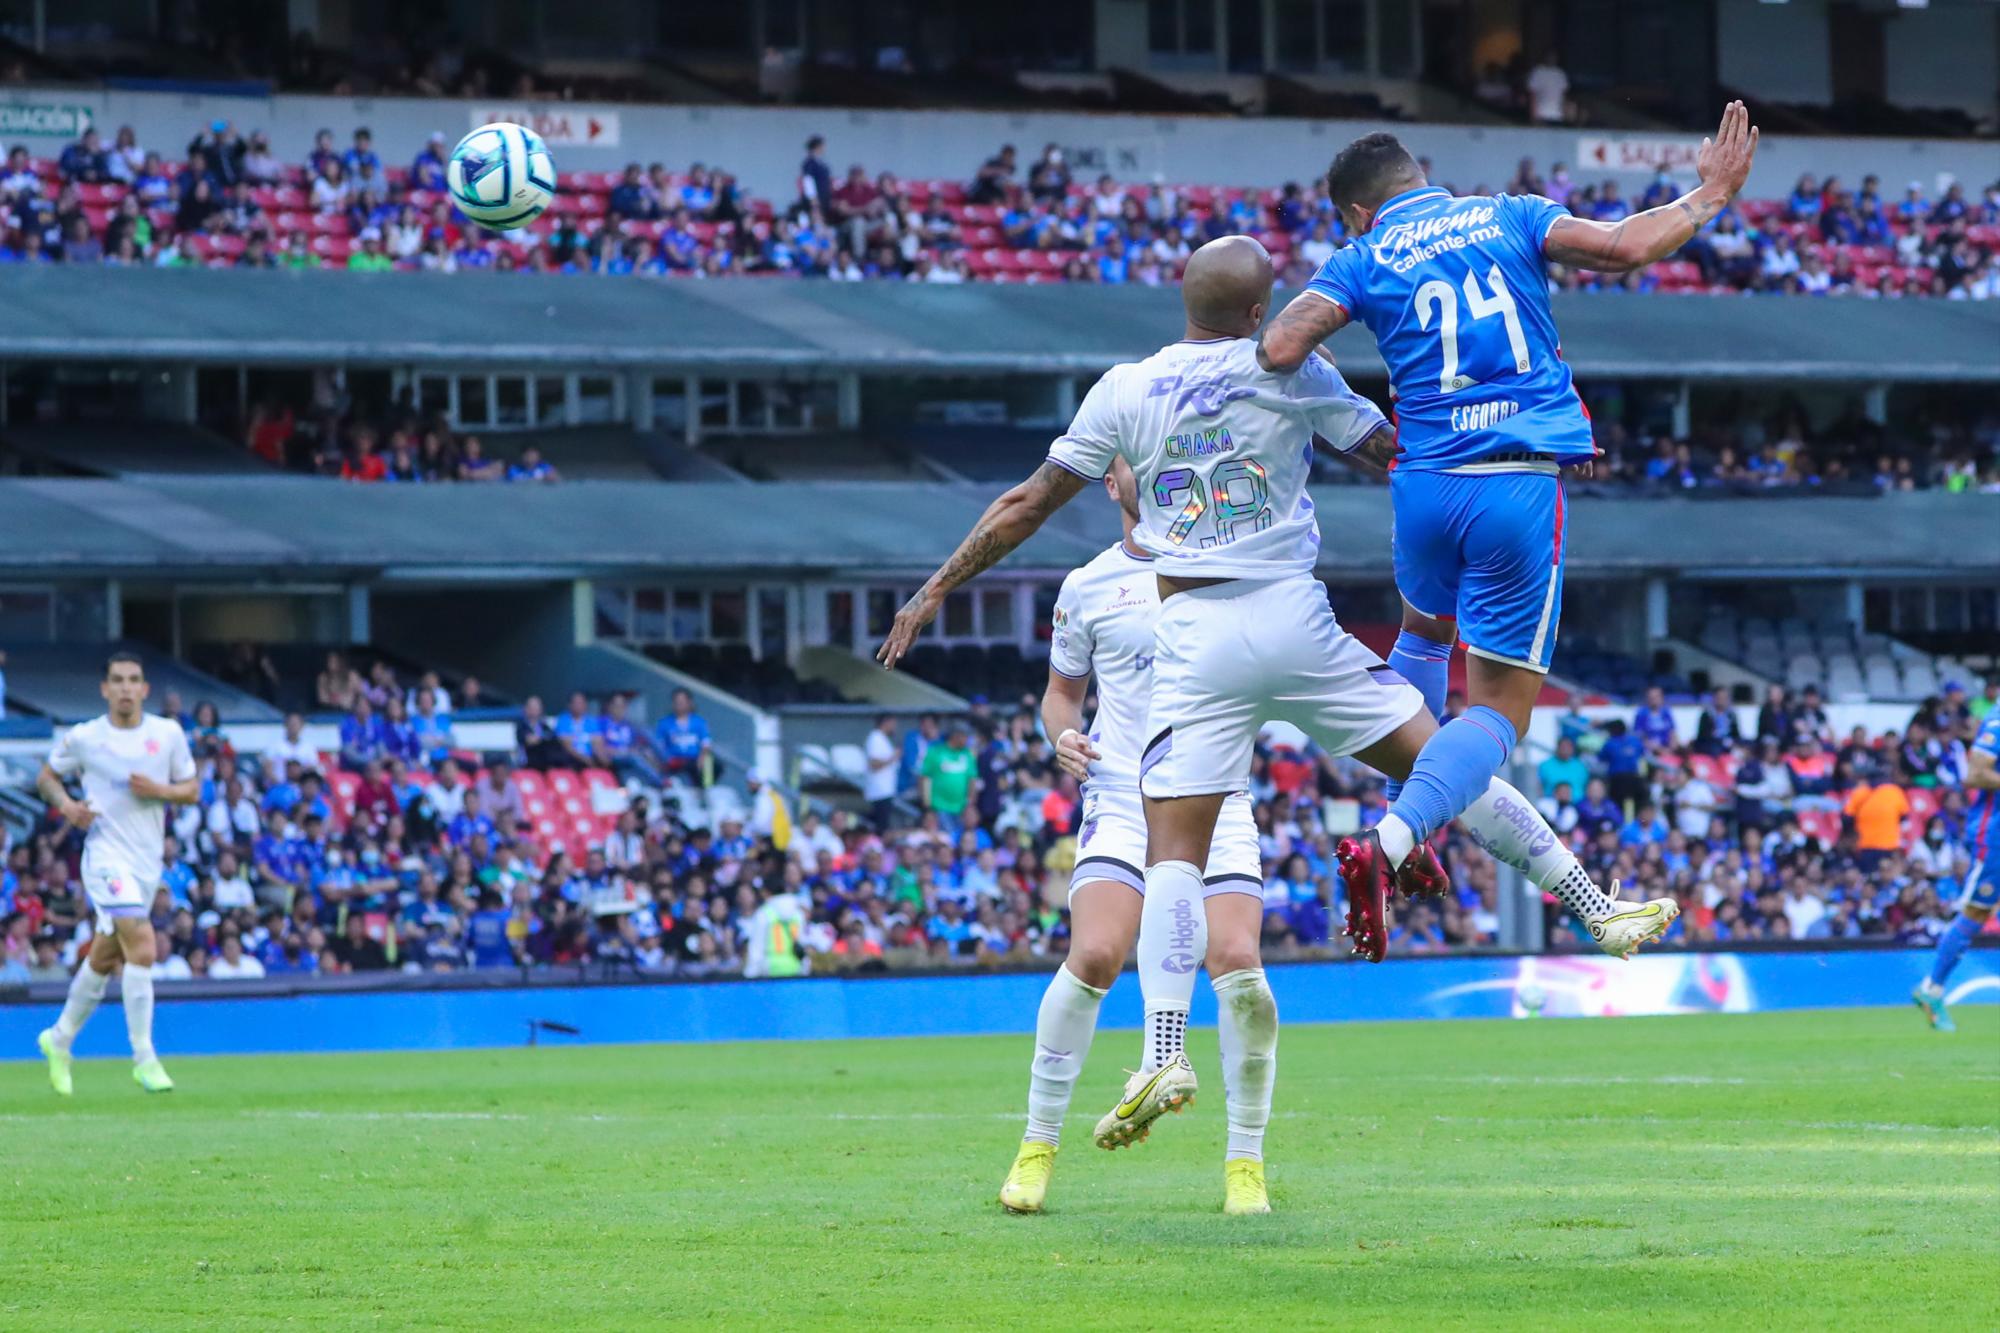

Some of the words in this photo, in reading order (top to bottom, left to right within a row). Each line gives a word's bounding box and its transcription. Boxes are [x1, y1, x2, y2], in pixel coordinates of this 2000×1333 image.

[1369, 206, 1494, 264] Caliente
[1393, 225, 1503, 273] caliente.mx
[1414, 263, 1531, 393] 24
[1165, 428, 1234, 459] CHAKA
[1153, 458, 1271, 549] 28
[1493, 796, 1540, 843] Hágalo
[1168, 899, 1199, 949] Hágalo
